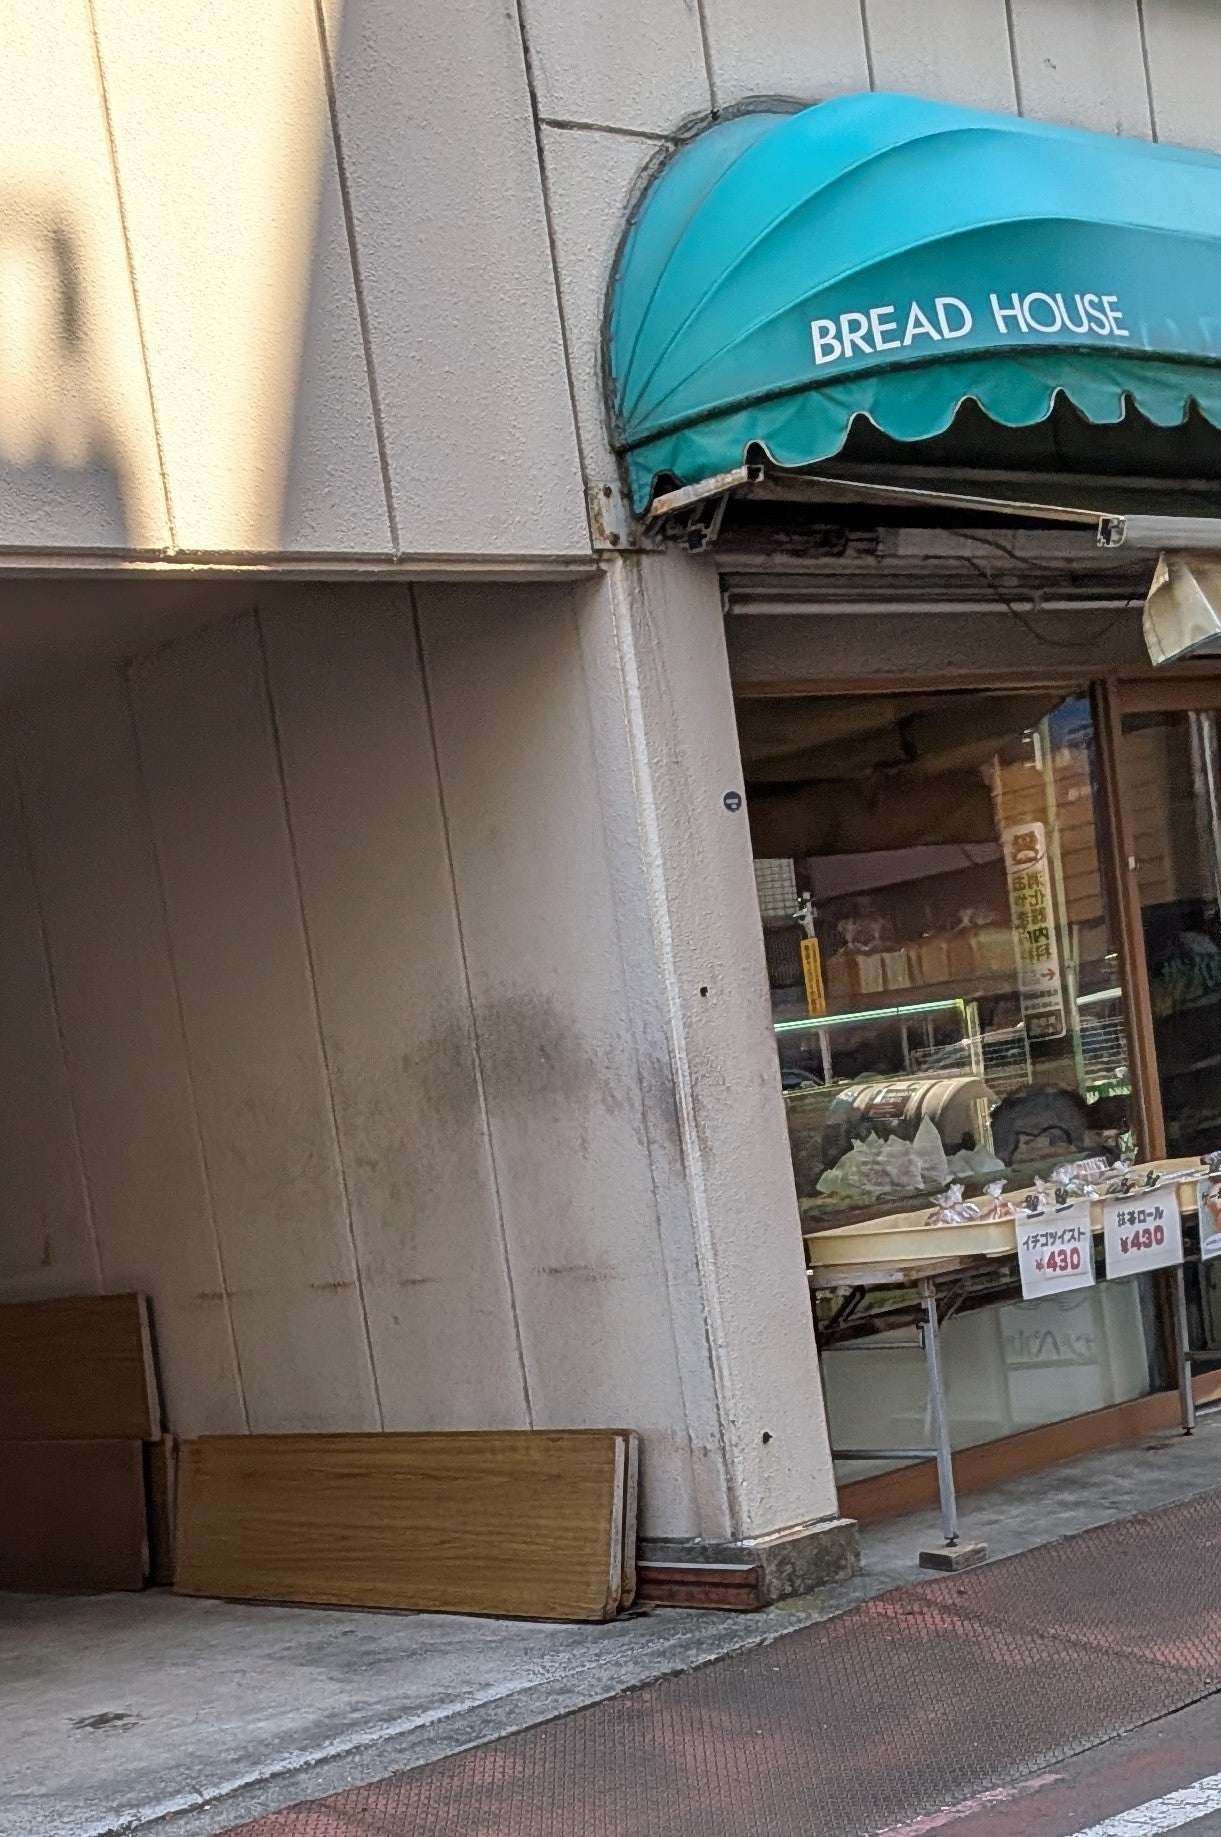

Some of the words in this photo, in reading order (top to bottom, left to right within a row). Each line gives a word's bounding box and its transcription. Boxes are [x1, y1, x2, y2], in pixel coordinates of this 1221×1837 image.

[810, 297, 973, 365] BREAD
[990, 292, 1130, 336] HOUSE
[1022, 1226, 1086, 1251] イチゴツイスト
[1119, 1224, 1165, 1255] ¥430
[1035, 1246, 1081, 1273] ¥430
